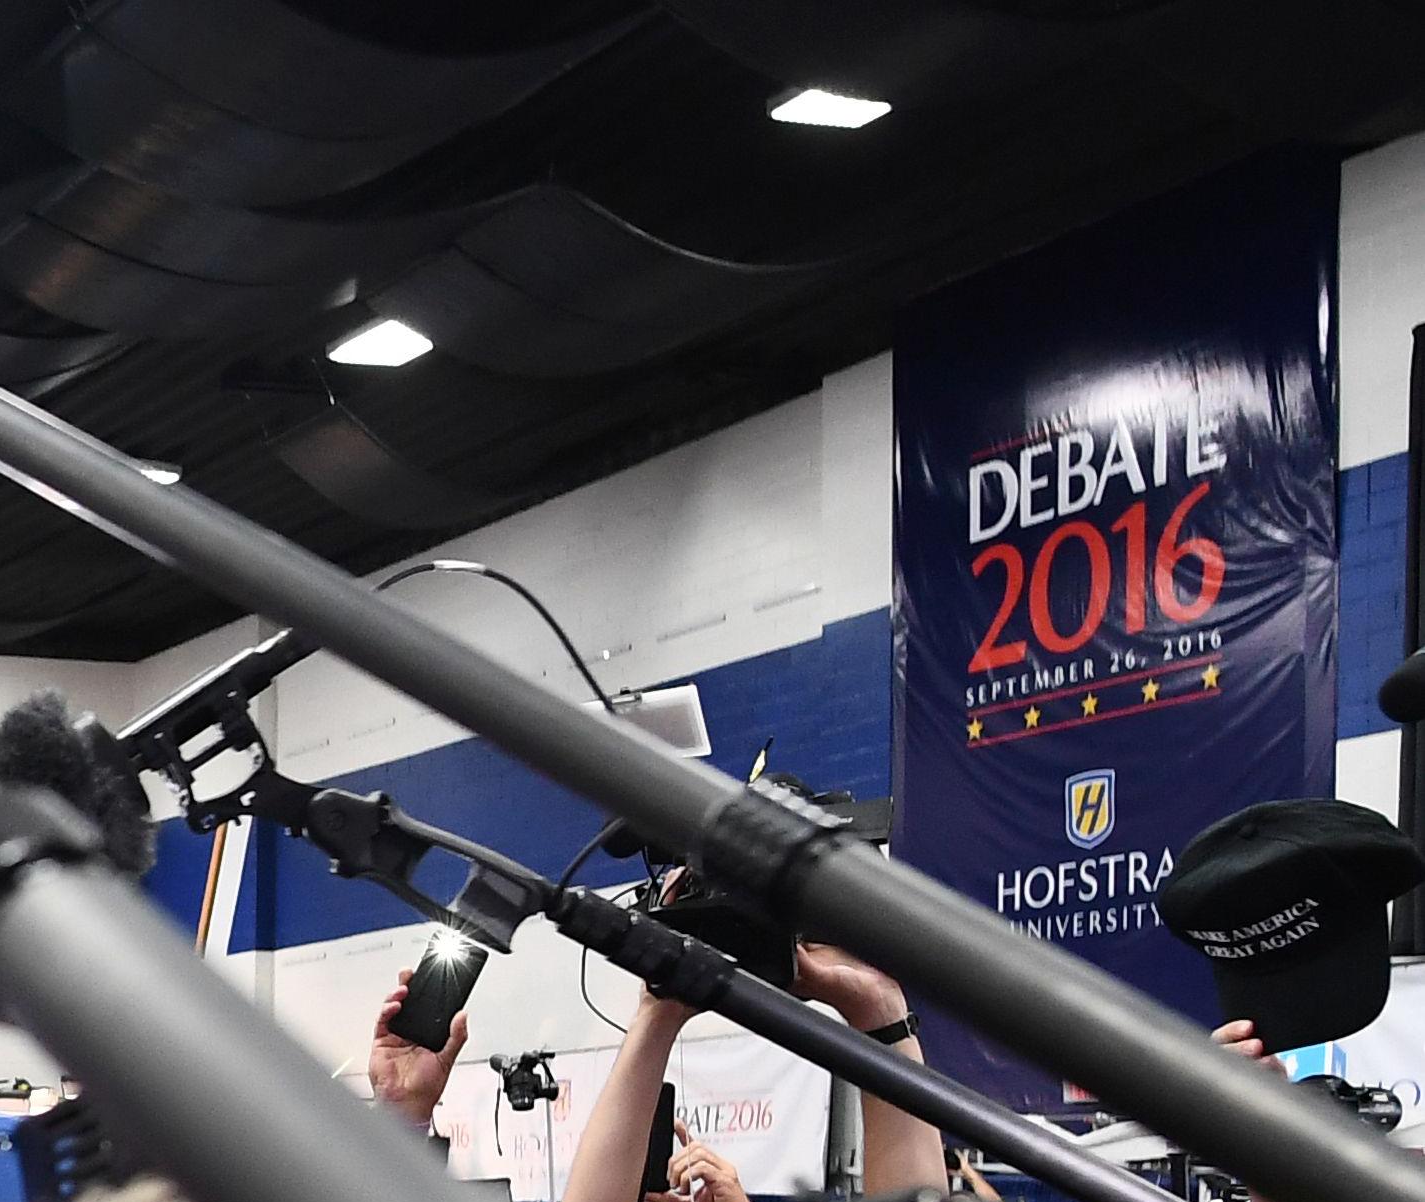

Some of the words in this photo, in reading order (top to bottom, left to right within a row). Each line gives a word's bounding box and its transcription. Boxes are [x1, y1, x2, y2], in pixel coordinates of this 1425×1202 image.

[969, 394, 1227, 544] DEBATE
[967, 481, 1226, 673] 2016
[965, 657, 1094, 708] SEPTEMBER
[1163, 627, 1222, 660] 2016
[997, 846, 1174, 914] HOFSTRA
[1232, 898, 1319, 941] AMERICA
[1260, 916, 1320, 951] AGAIN
